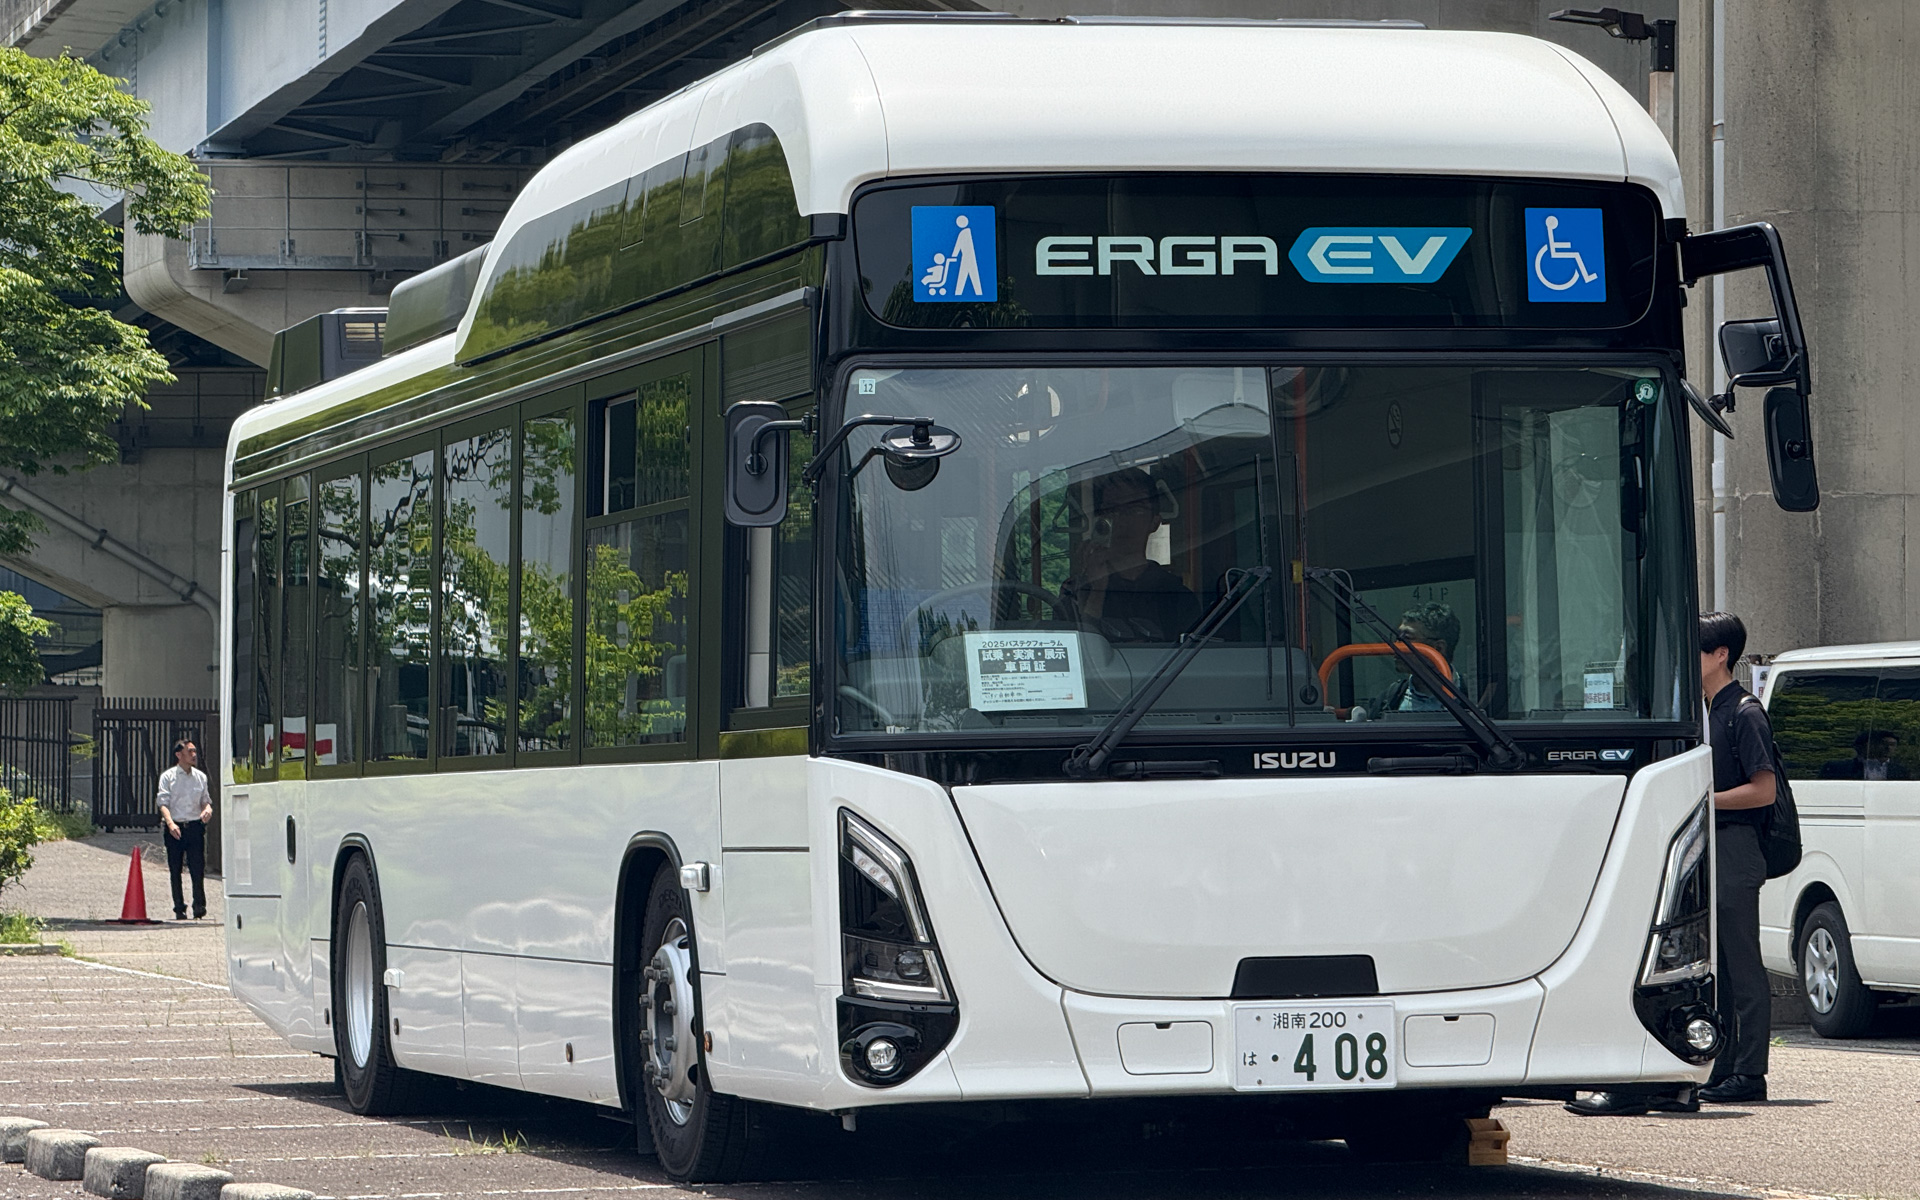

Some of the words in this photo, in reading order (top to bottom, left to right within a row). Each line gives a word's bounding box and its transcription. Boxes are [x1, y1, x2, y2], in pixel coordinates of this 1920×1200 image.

[1036, 236, 1278, 275] ERGA
[1307, 236, 1447, 275] EV
[864, 383, 873, 392] 12
[1643, 387, 1649, 396] 7
[982, 640, 1063, 648] 2025バステクフォーラム
[981, 648, 1066, 660] 試乗・実演・展示
[1004, 660, 1046, 672] 車両証
[1253, 752, 1336, 769] ISUZU
[1547, 751, 1597, 760] ERGA
[1601, 749, 1631, 760] EV
[1243, 1051, 1258, 1067] は
